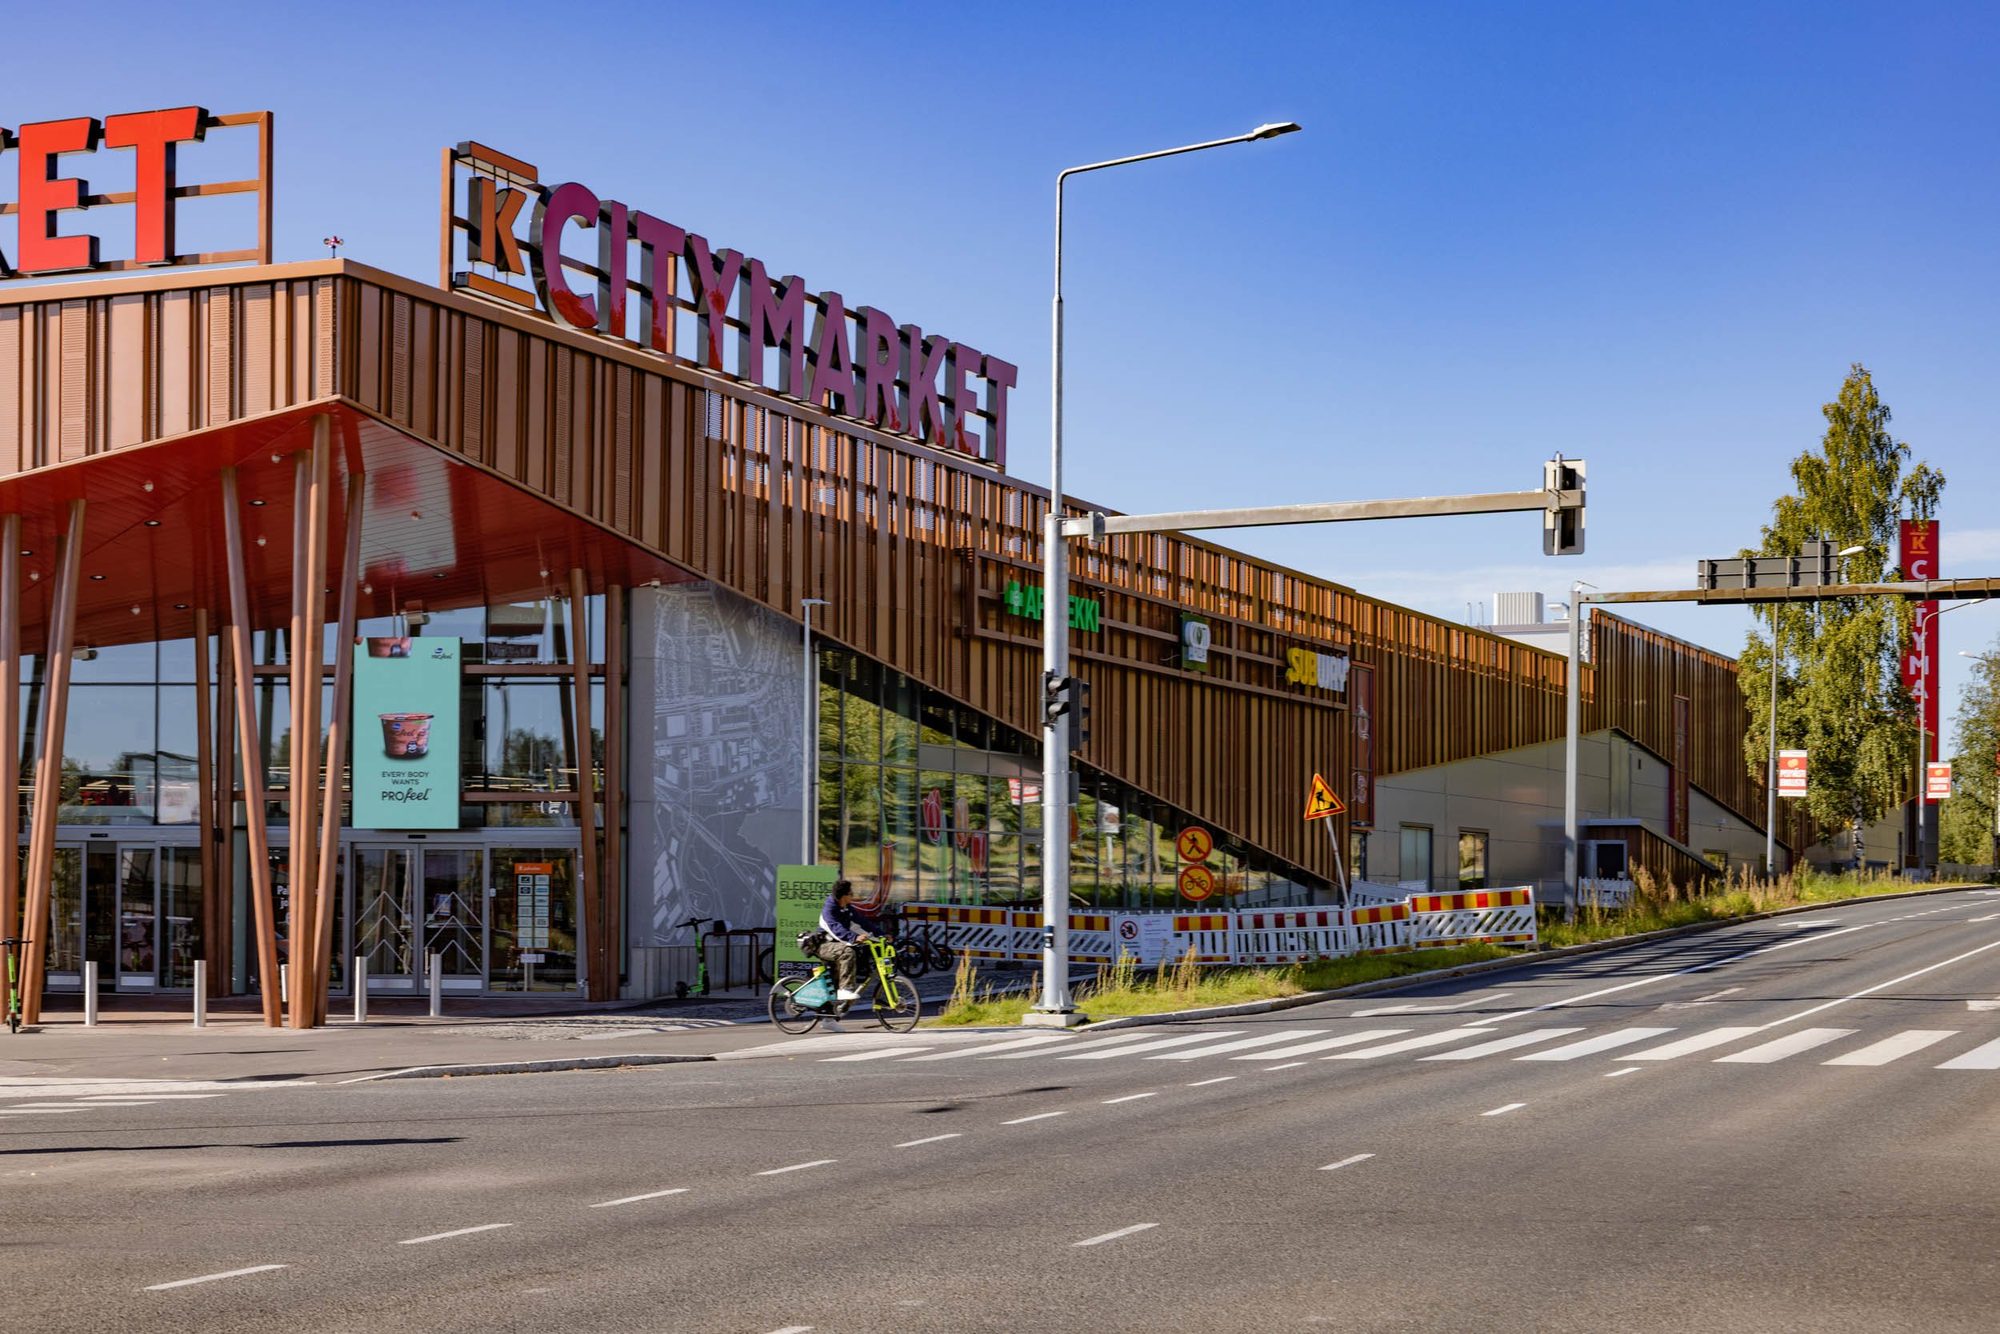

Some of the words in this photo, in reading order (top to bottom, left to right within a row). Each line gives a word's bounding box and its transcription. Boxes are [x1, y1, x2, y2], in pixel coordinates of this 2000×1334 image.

[0, 105, 208, 276] ET
[468, 176, 527, 275] K
[530, 182, 1018, 467] CITYMARKET
[1286, 648, 1350, 692] SUBWAY
